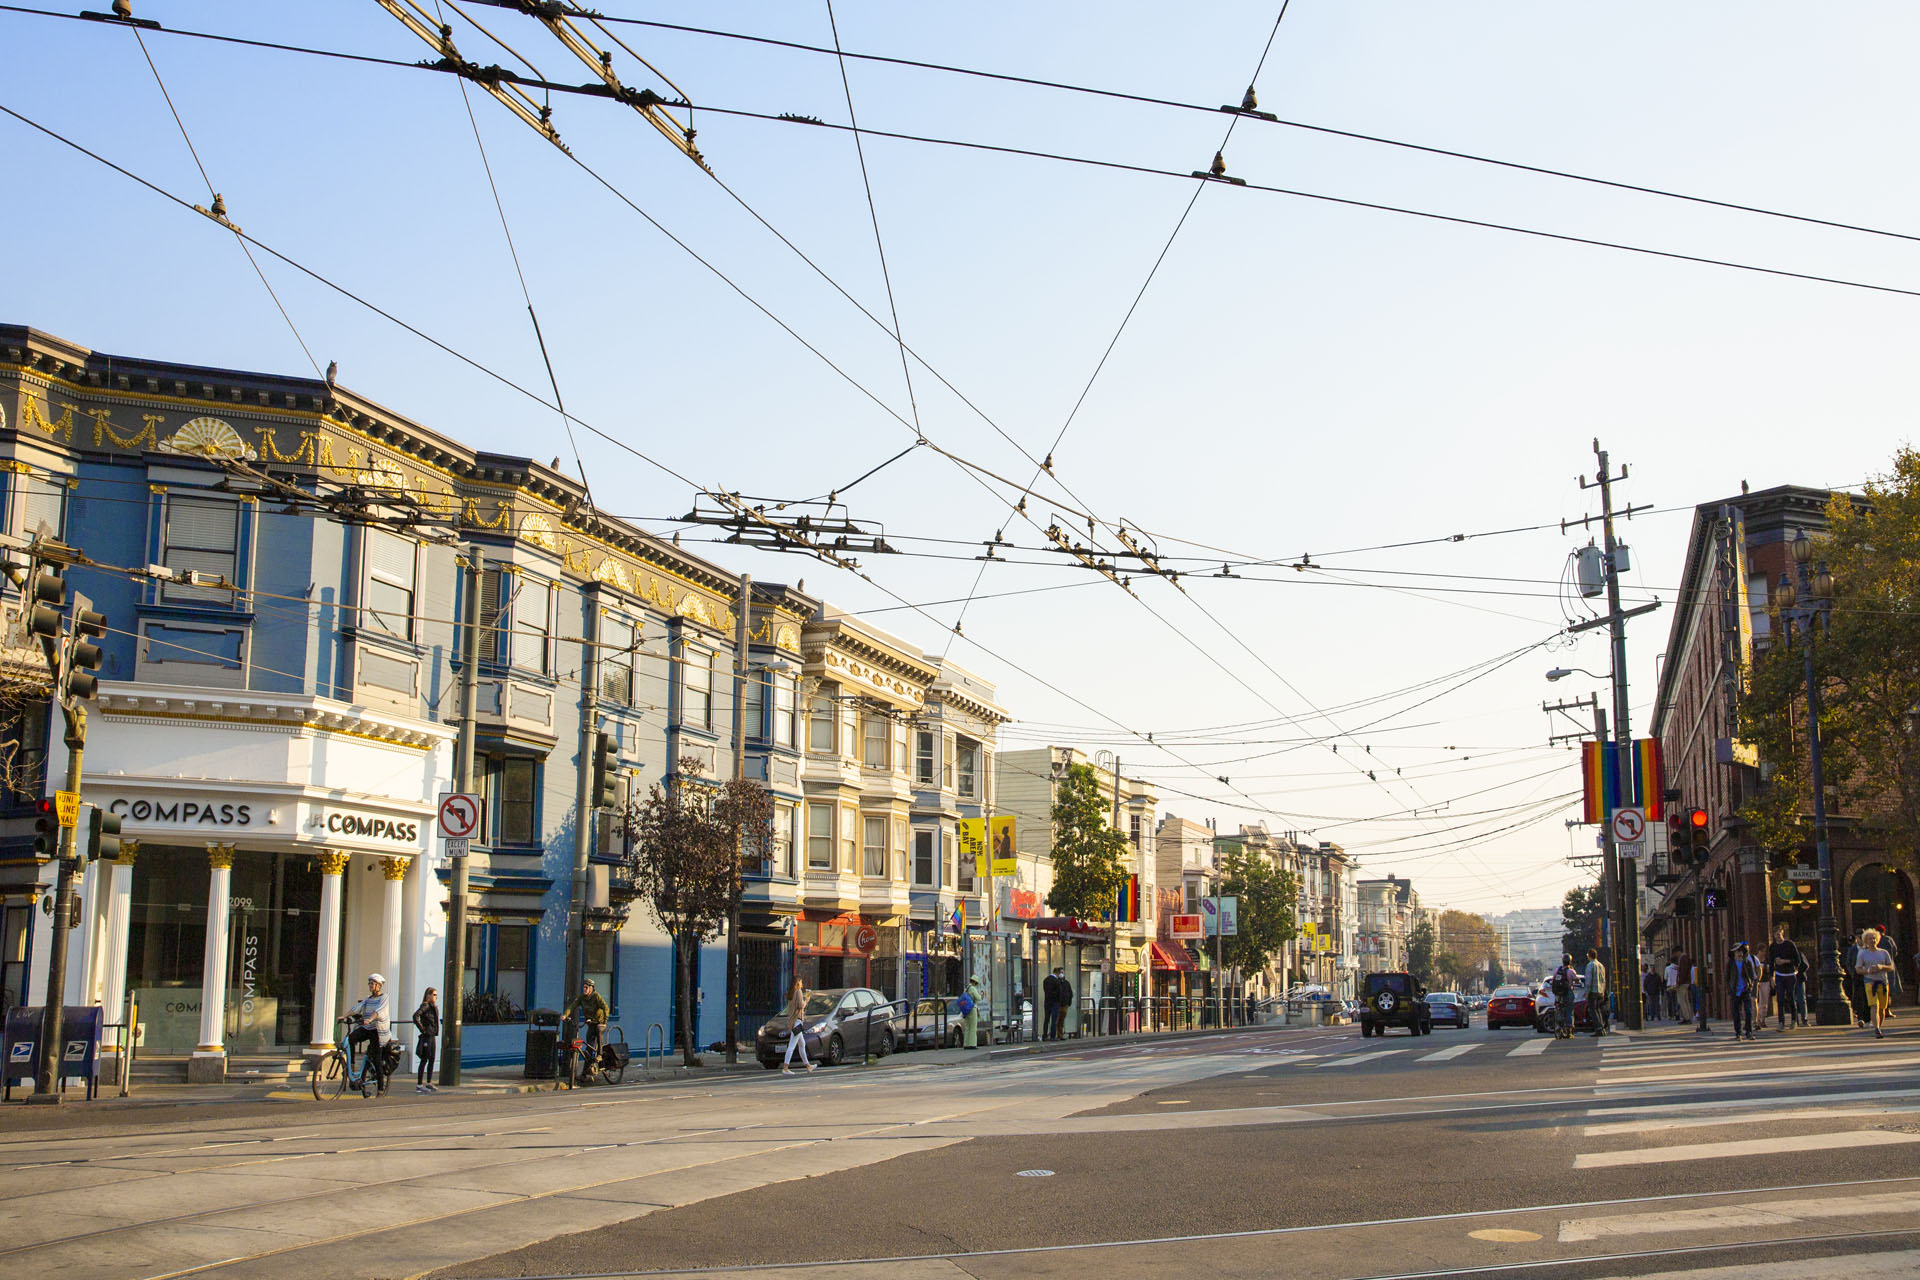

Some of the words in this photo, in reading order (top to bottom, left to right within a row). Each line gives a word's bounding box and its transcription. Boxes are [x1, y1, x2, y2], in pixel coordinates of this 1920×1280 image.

[110, 799, 251, 825] COMPASS
[328, 813, 417, 842] COMPASS
[447, 840, 466, 848] EXCEPT
[229, 897, 252, 907] 2099
[241, 935, 258, 1027] COMPASS
[166, 1001, 229, 1013] COMS
